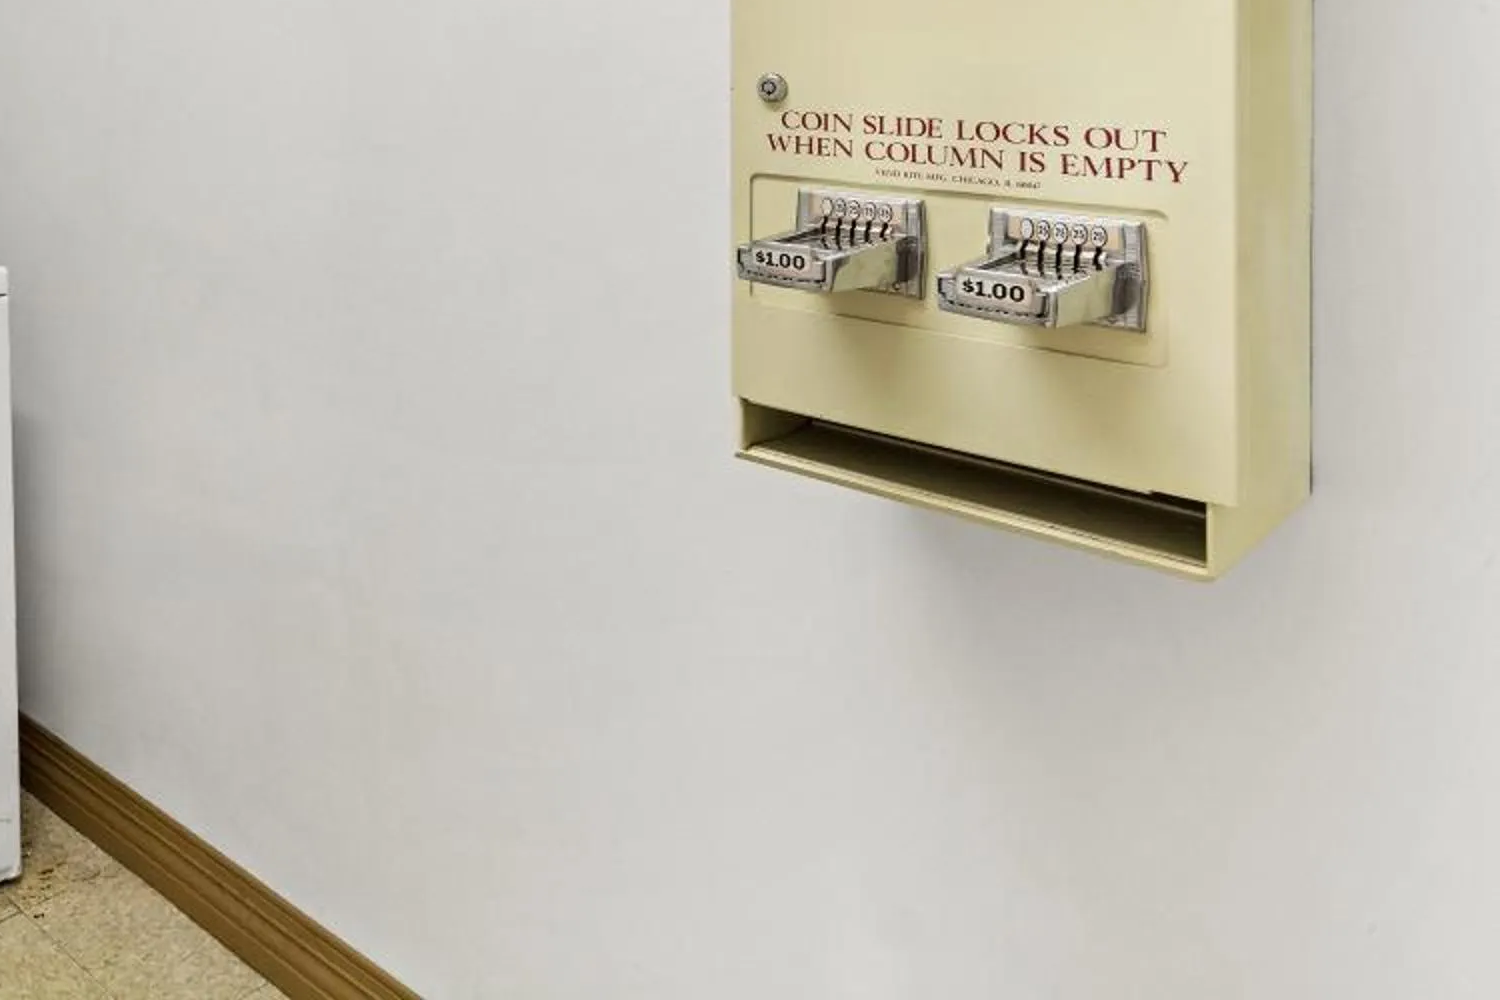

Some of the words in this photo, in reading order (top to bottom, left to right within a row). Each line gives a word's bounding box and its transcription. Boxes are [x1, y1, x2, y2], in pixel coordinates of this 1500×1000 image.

[781, 111, 853, 134] COIN
[862, 115, 943, 139] SLIDE
[956, 119, 1070, 148] LOCKS
[1084, 127, 1167, 153] OUT
[767, 133, 853, 158] WHEN
[865, 141, 1004, 170] COLUMN
[1018, 151, 1045, 173] IS
[1060, 153, 1189, 183] EMPTY
[755, 249, 806, 270] $1.00
[962, 277, 1025, 303] $1.00
